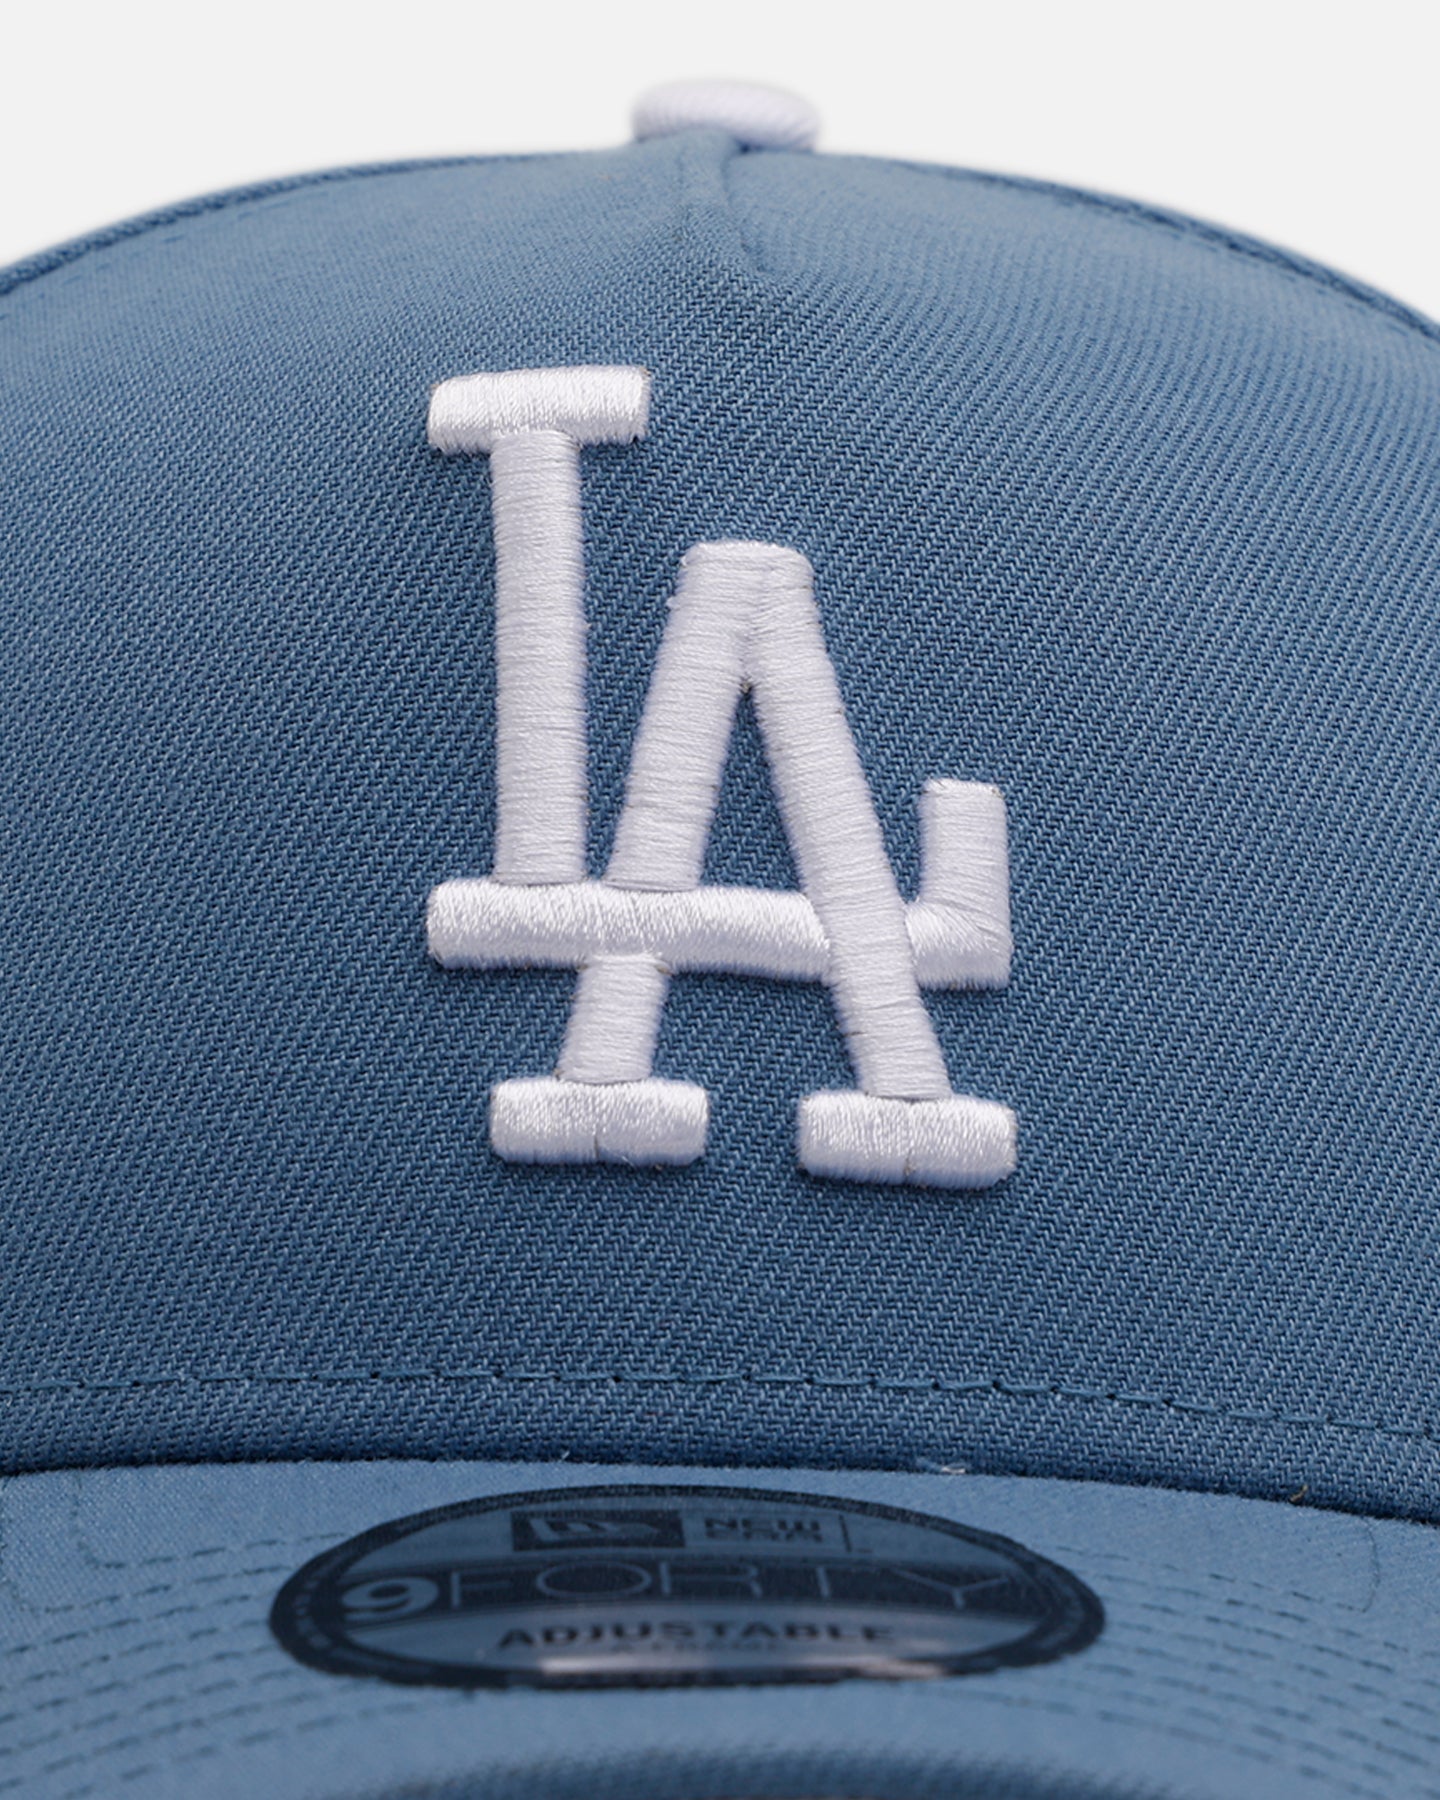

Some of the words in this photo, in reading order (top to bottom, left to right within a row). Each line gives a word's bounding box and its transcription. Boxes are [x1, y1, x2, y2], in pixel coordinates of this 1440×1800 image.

[427, 365, 1017, 1188] LA
[704, 1517, 821, 1531] NEW
[497, 1619, 894, 1650] ADJUSTABLE
